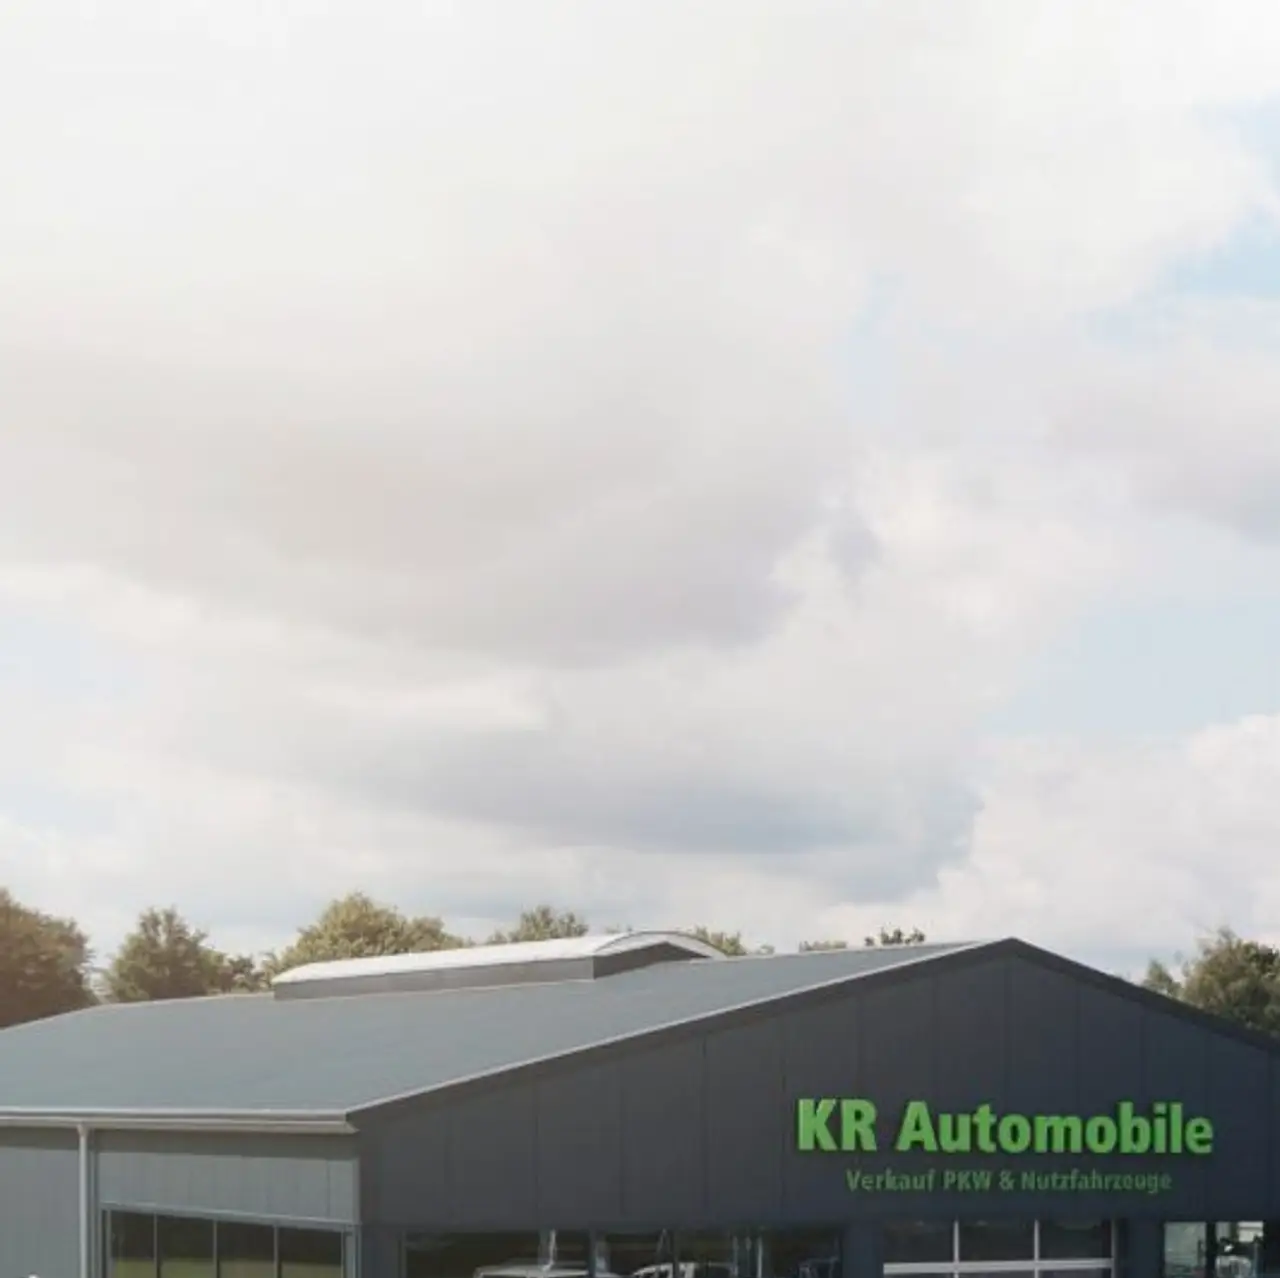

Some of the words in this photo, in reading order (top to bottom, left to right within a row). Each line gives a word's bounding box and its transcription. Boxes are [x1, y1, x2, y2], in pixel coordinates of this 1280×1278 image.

[799, 1098, 877, 1151] KR
[897, 1100, 1213, 1154] Automobile
[846, 1168, 936, 1191] Verkauf
[944, 1169, 992, 1191] PKW
[999, 1170, 1015, 1191] &
[1021, 1168, 1173, 1194] Nutzfahrzeuge
